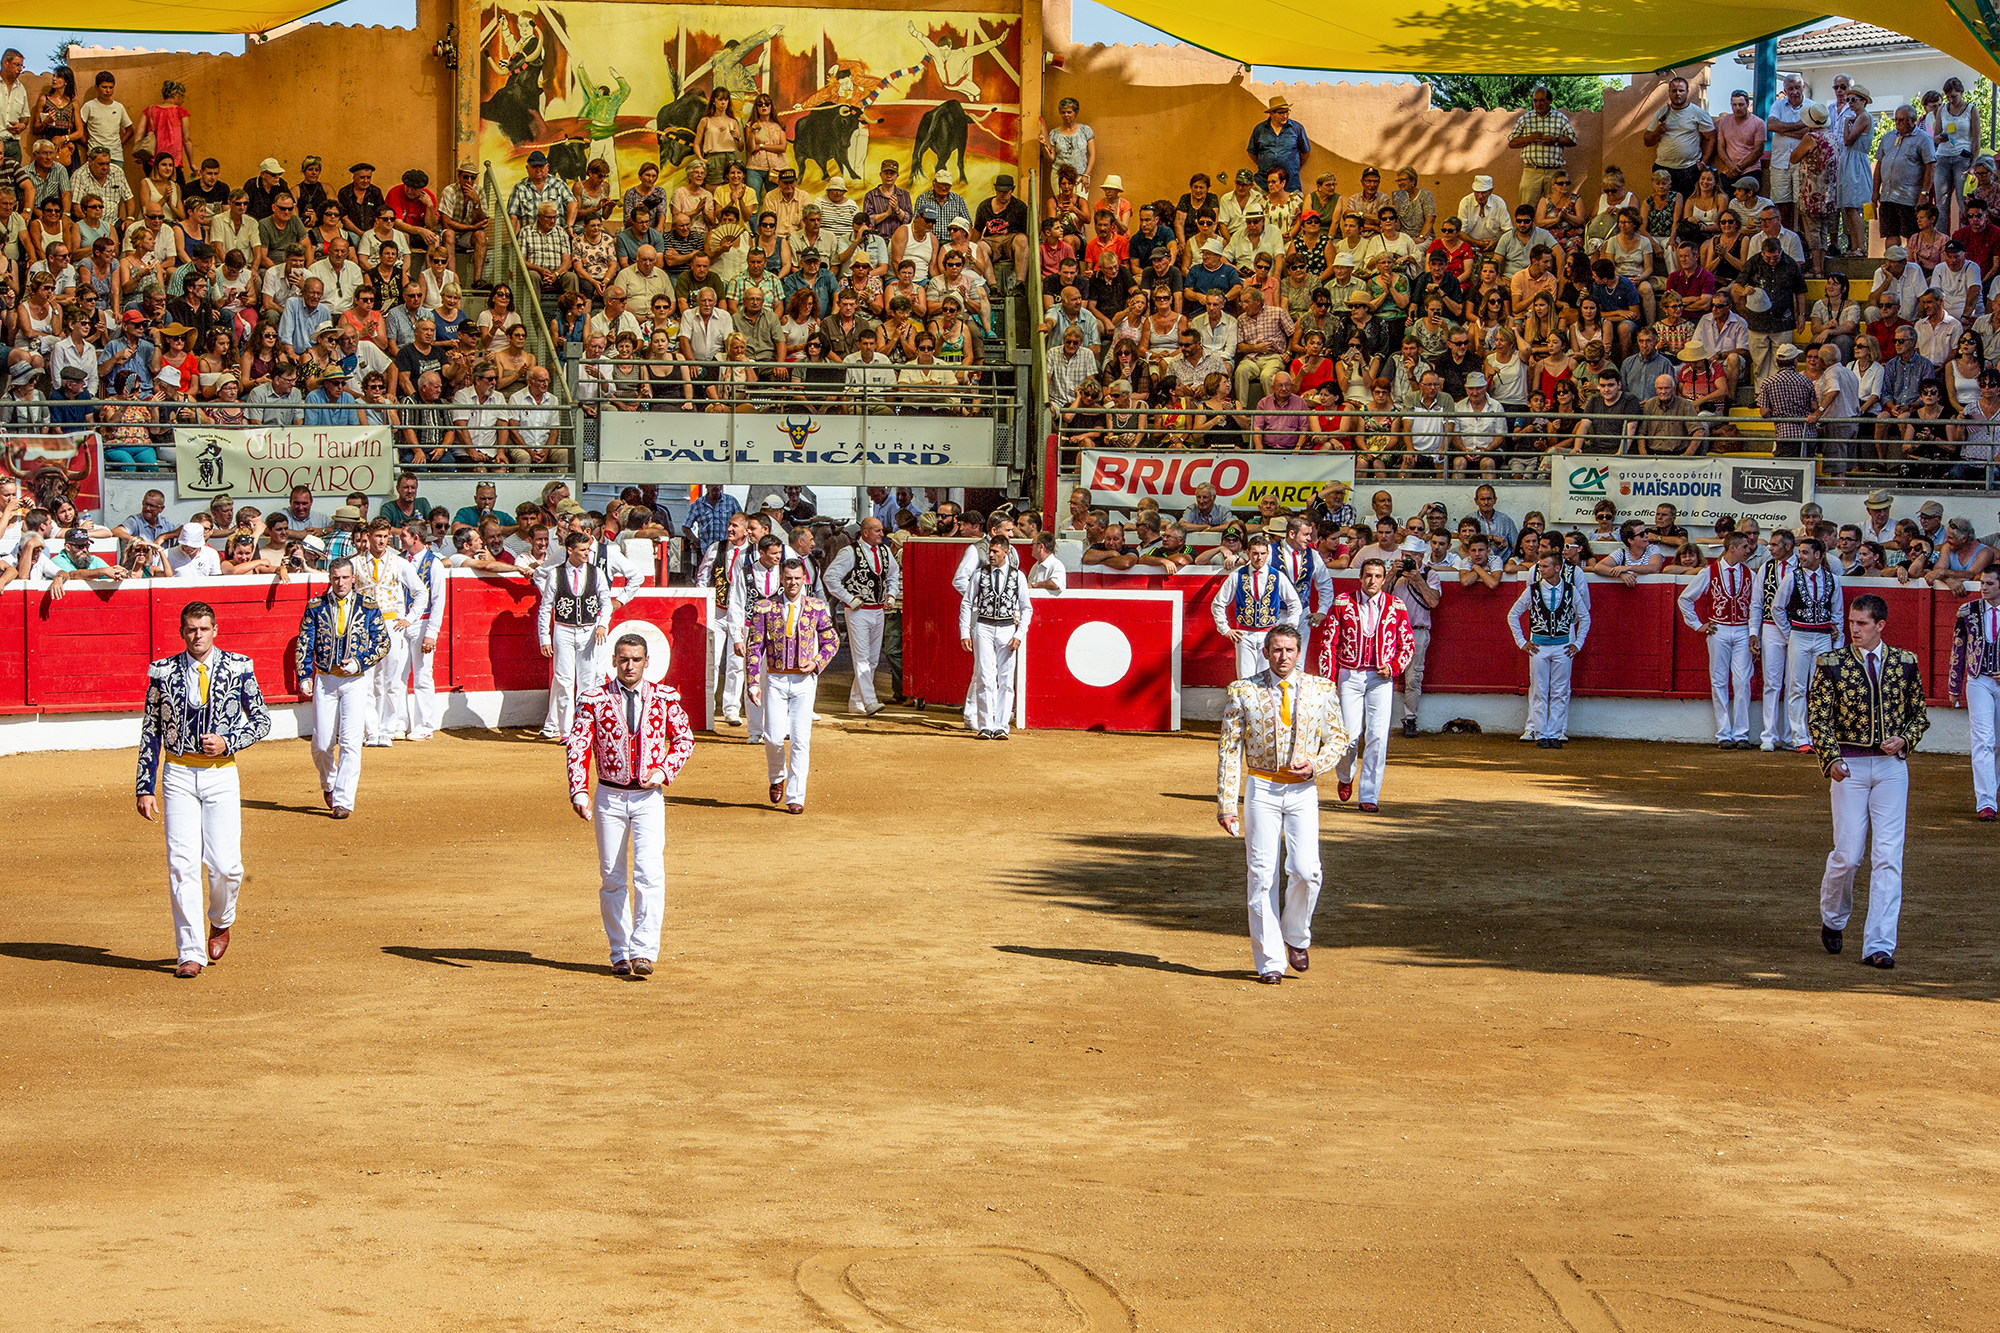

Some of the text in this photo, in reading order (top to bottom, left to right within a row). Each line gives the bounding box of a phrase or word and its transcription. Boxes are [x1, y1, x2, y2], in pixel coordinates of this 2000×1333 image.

[246, 432, 382, 460] Club Taurin
[644, 438, 951, 451] CLUBS TAURINS
[644, 449, 950, 465] PAUL RICARD
[247, 465, 374, 493] NOGARO
[1090, 456, 1249, 497] BRICO
[1619, 471, 1722, 480] groupe coopératif
[1740, 474, 1794, 493] TURSAN
[1632, 478, 1721, 497] MAÏSADOUR
[1741, 512, 1787, 521] Landaise
